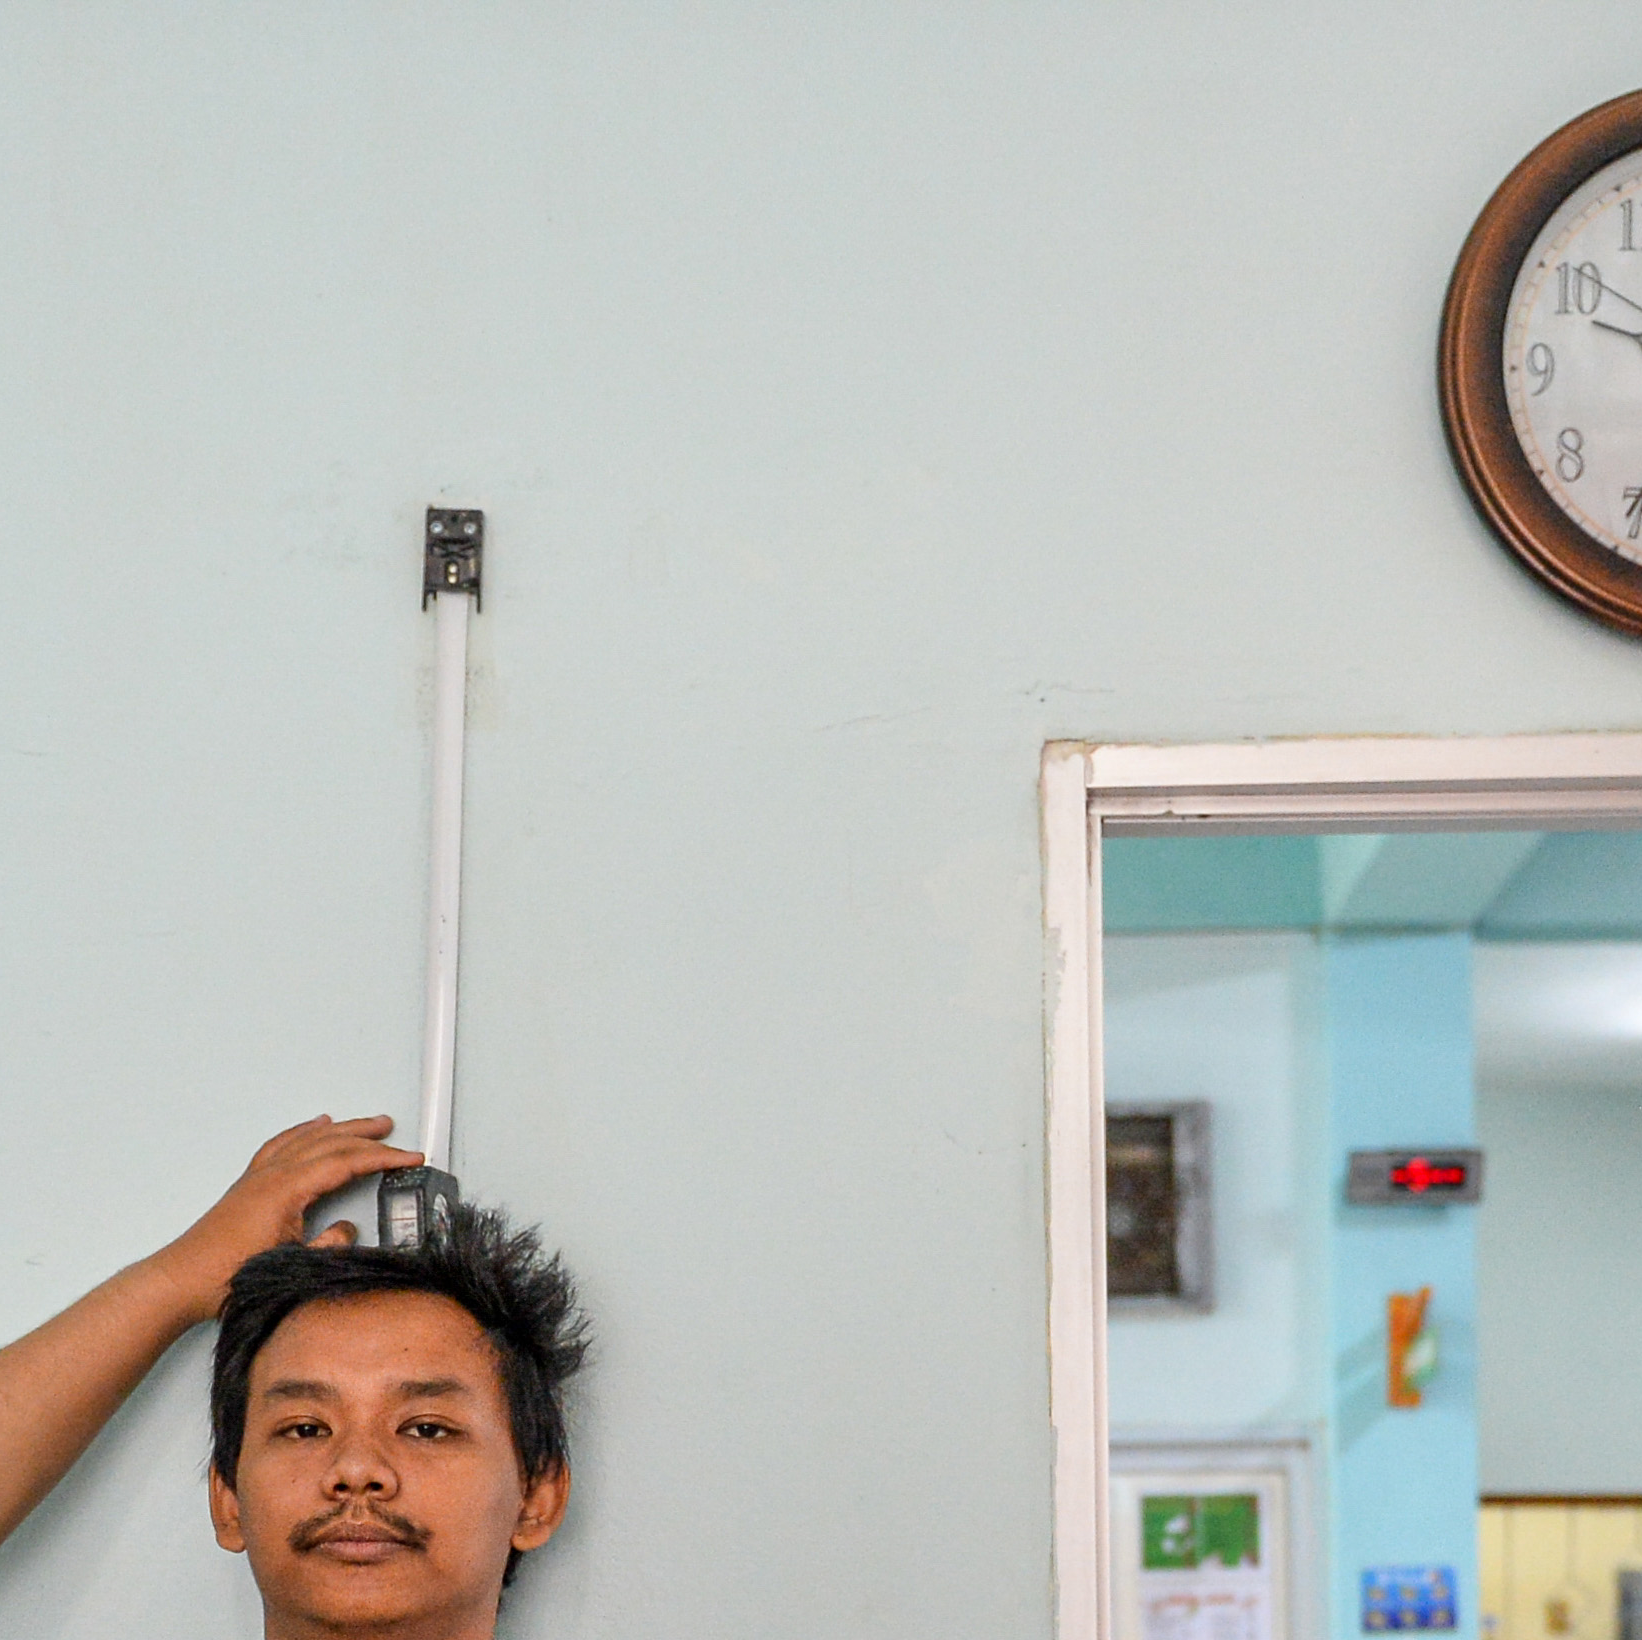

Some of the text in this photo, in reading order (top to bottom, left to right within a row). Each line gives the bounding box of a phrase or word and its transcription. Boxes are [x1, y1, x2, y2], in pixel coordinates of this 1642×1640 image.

[1555, 261, 1602, 315] 10
[1526, 343, 1555, 396] 9
[1557, 427, 1584, 482] 8
